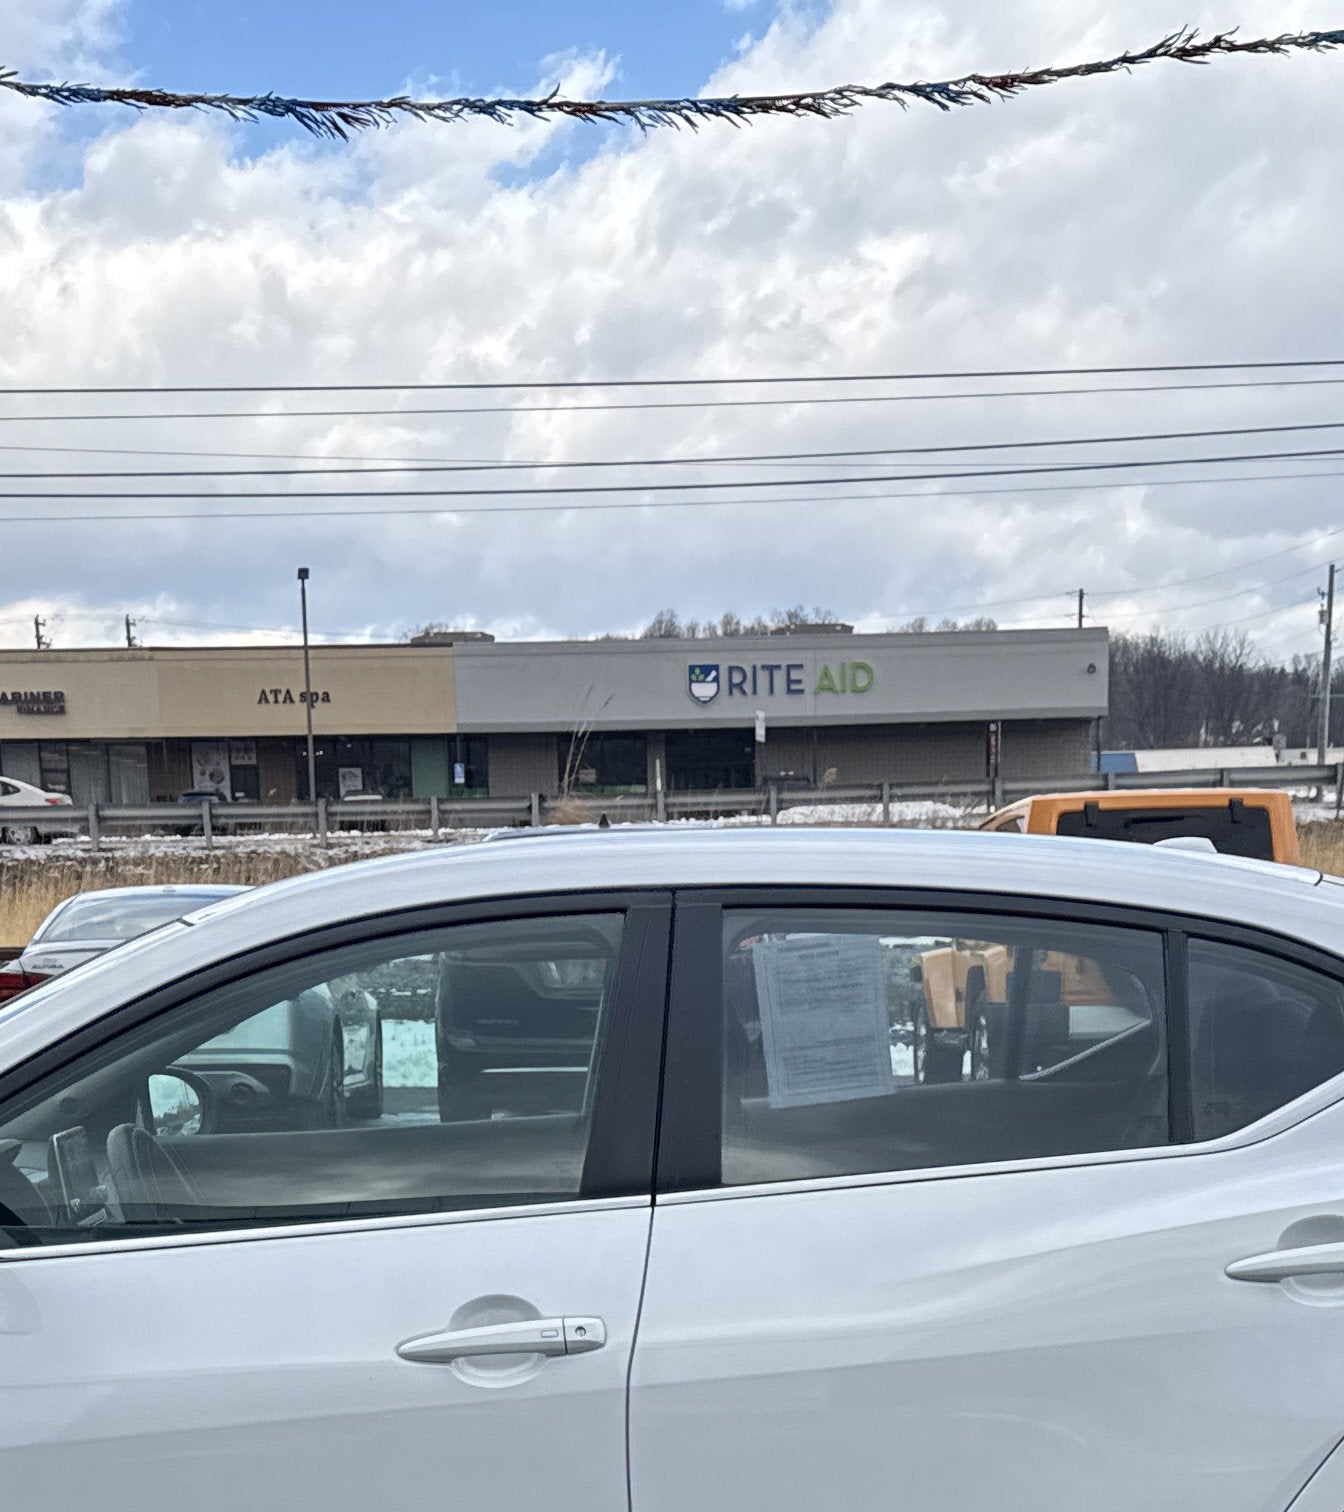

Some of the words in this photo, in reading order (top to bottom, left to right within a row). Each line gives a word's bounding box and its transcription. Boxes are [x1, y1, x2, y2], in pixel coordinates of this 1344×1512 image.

[728, 663, 805, 697] RITE
[813, 661, 875, 694] AID
[257, 688, 296, 705] ATA
[299, 691, 331, 708] spa
